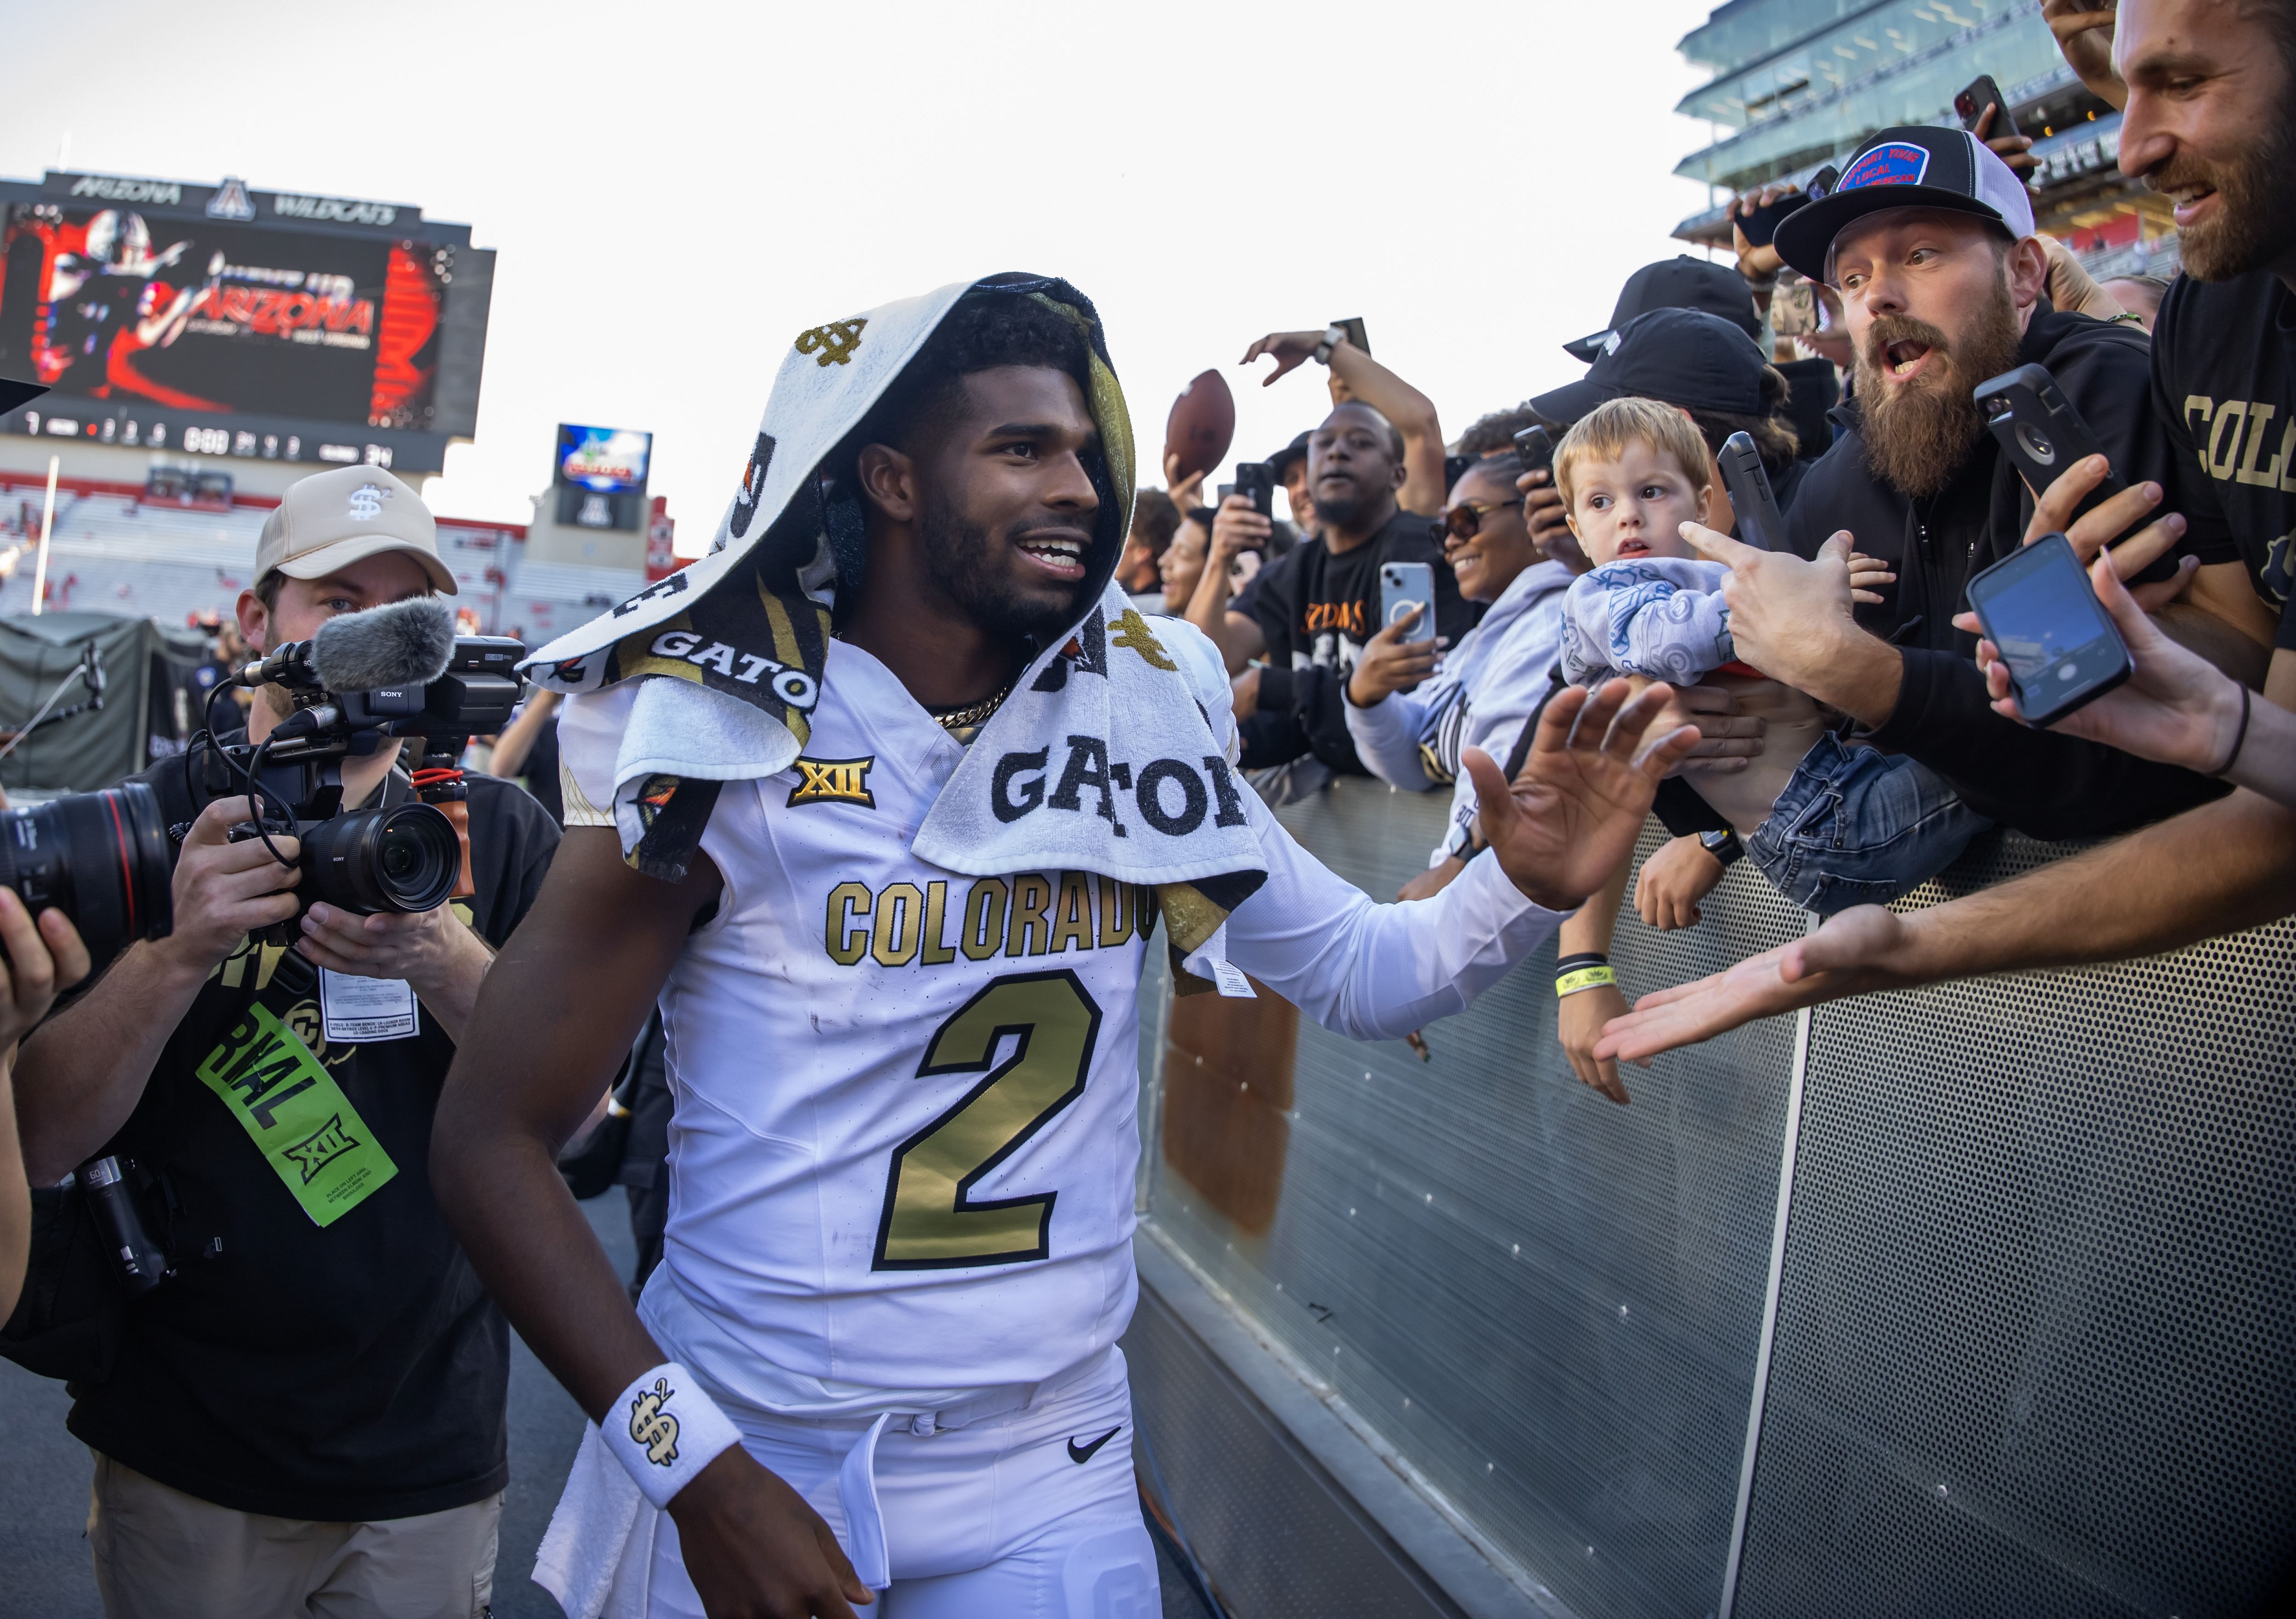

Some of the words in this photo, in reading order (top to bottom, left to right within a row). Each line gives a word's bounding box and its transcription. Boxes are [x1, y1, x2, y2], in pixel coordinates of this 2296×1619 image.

[1840, 150, 1884, 191] SUPPORT
[1888, 148, 1920, 163] YOUR
[1856, 164, 1891, 185] LOCAL
[70, 176, 182, 205] ARIZONA
[274, 194, 398, 226] WILDCATS
[188, 284, 375, 335] ARIZONA
[650, 631, 818, 717] GATO
[871, 968, 1103, 1272] 2
[326, 1187, 340, 1198] PLACE
[346, 1174, 357, 1183] LEFT
[328, 1187, 348, 1204] BETWEEN
[348, 1176, 362, 1189] ELBOW
[362, 1170, 372, 1178] AND
[342, 1182, 365, 1200] SHOULDER
